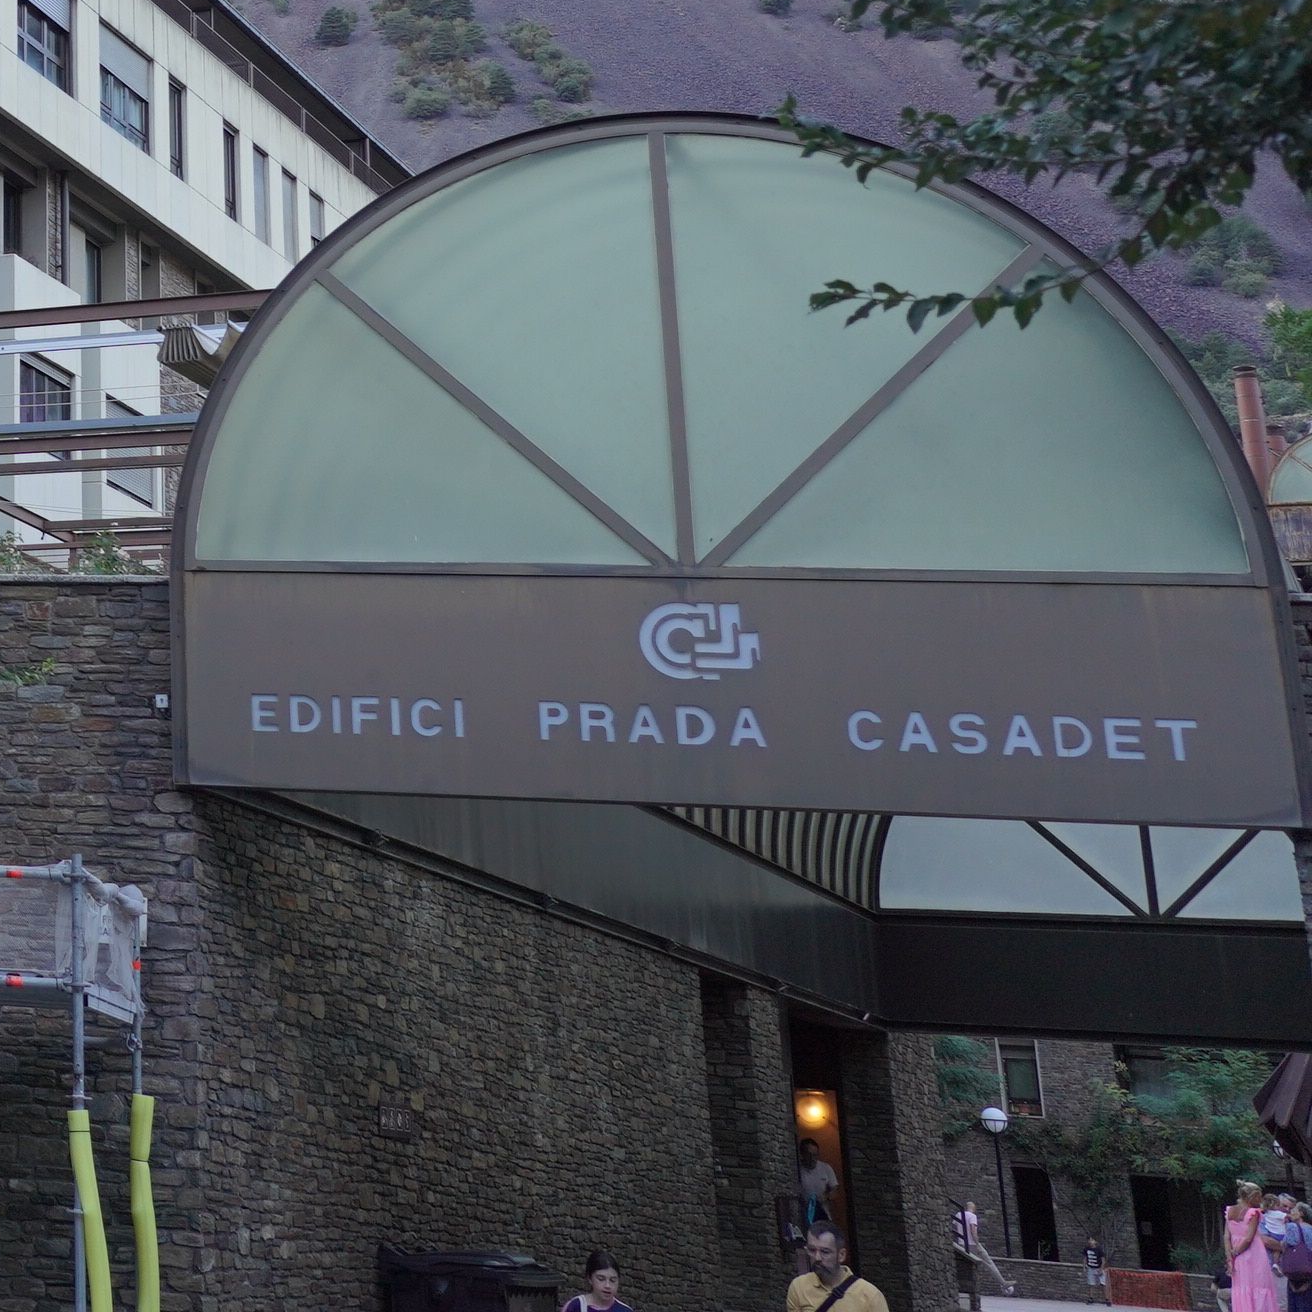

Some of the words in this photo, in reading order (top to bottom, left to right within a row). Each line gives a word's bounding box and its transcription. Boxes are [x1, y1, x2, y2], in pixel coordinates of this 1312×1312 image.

[251, 694, 465, 738] EDIFICI
[538, 701, 768, 748] PRADA
[847, 710, 1198, 761] CASADET
